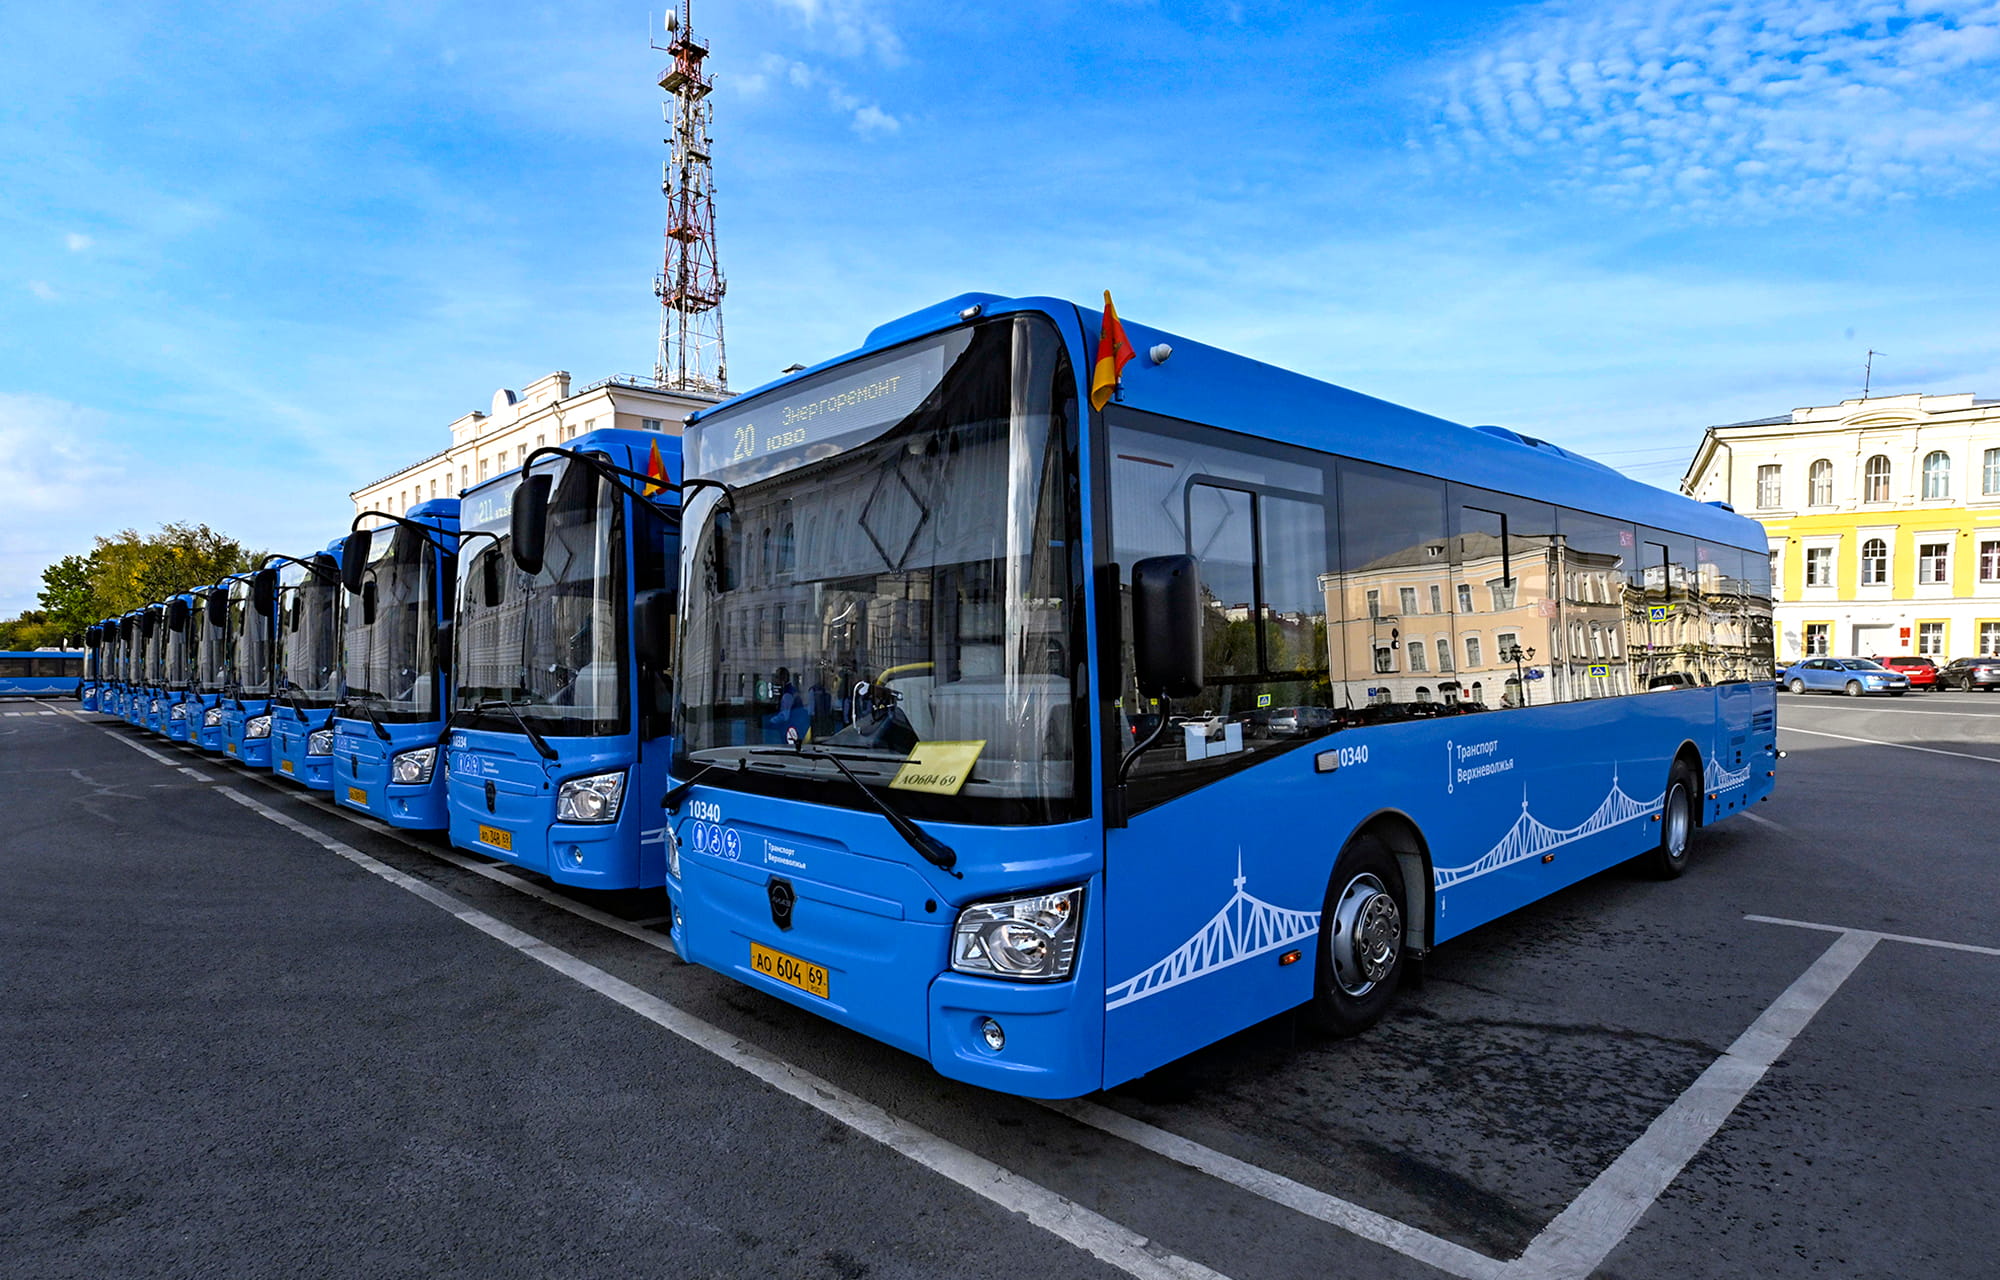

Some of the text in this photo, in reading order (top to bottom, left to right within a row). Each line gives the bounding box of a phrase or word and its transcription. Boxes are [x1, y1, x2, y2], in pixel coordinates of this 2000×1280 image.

[782, 375, 901, 426] Энергоремонт
[733, 424, 756, 461] 20
[479, 499, 493, 522] 211
[1456, 739, 1498, 763] Транспорт
[940, 774, 957, 786] 69
[1457, 758, 1514, 785] Верхневолжья
[688, 799, 720, 823] 10340
[757, 953, 823, 986] АО 604 69
